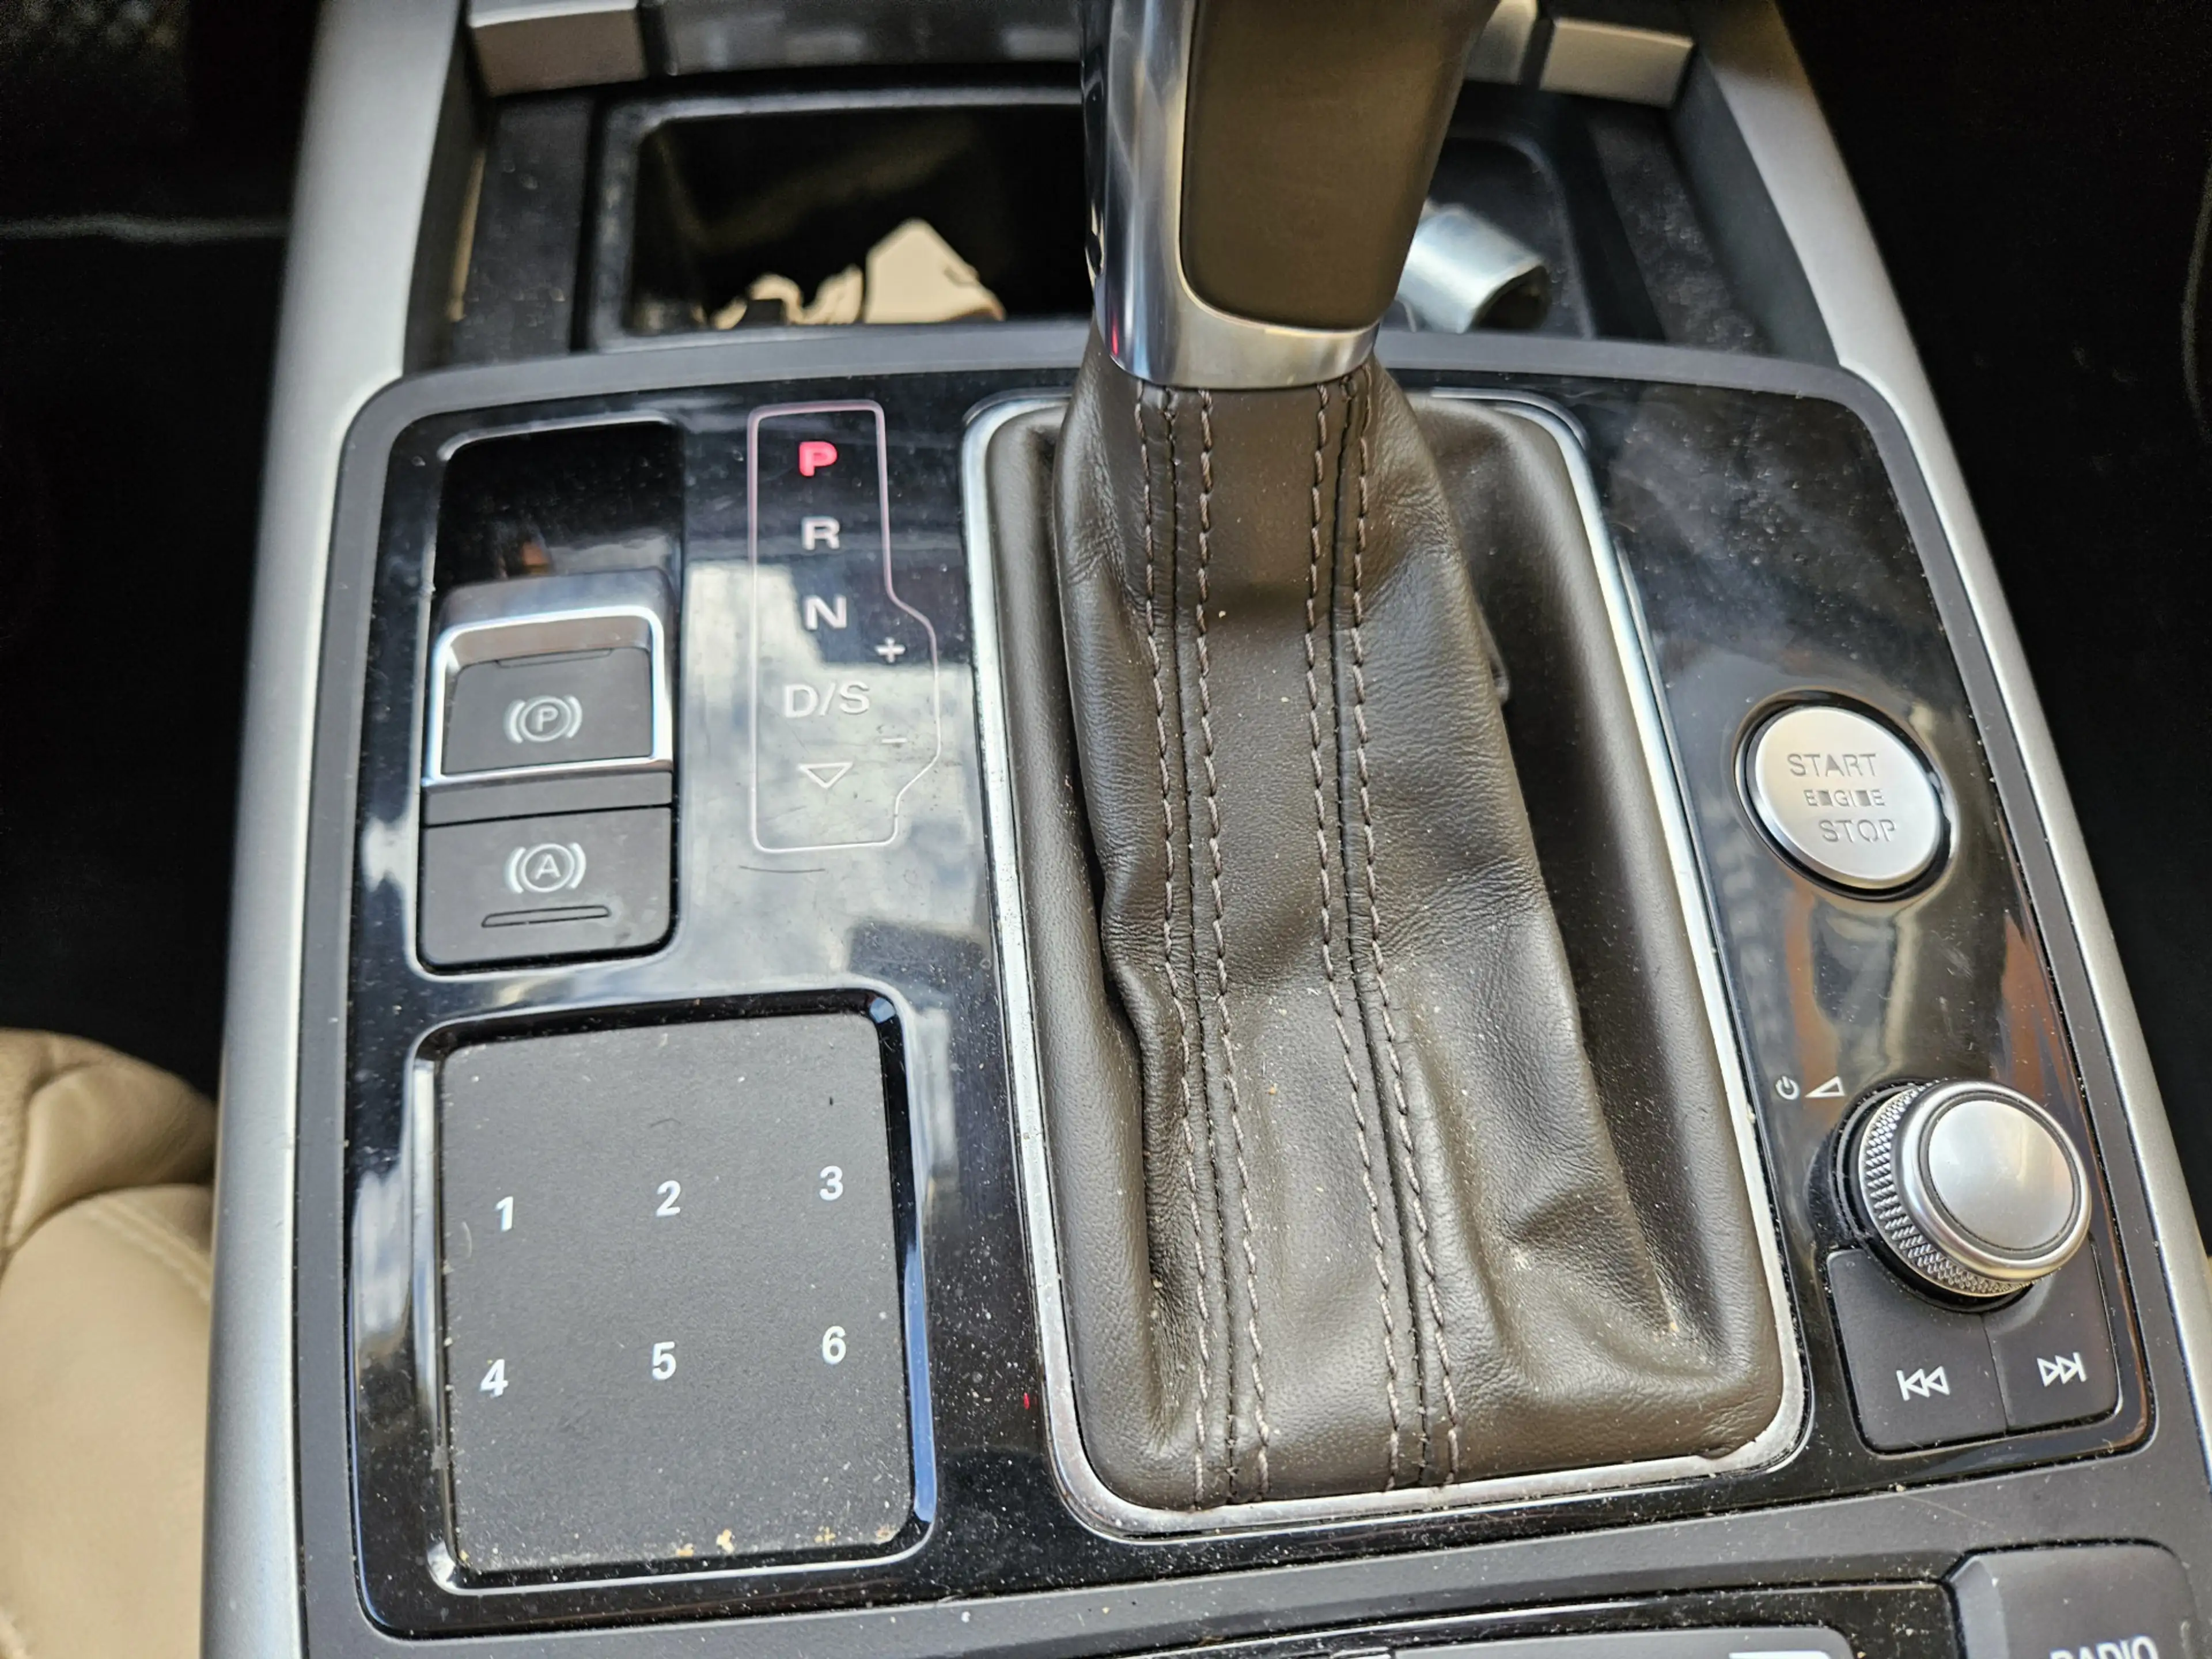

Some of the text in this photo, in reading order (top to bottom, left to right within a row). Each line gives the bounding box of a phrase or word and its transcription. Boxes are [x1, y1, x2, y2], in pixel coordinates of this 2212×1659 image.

[799, 441, 837, 476] P
[801, 517, 840, 550] R
[805, 596, 847, 630] N
[785, 681, 870, 718] D/S
[533, 707, 558, 732] P
[1787, 753, 1877, 778] START
[1819, 819, 1896, 843] STOP
[533, 854, 560, 880] A
[656, 1180, 681, 1217] 2
[819, 1165, 843, 1201] 3
[495, 1196, 514, 1231] 1
[652, 1342, 676, 1380] 5
[821, 1326, 846, 1365] 6
[480, 1359, 509, 1397] 4
[2049, 1635, 2160, 1659] DIO
